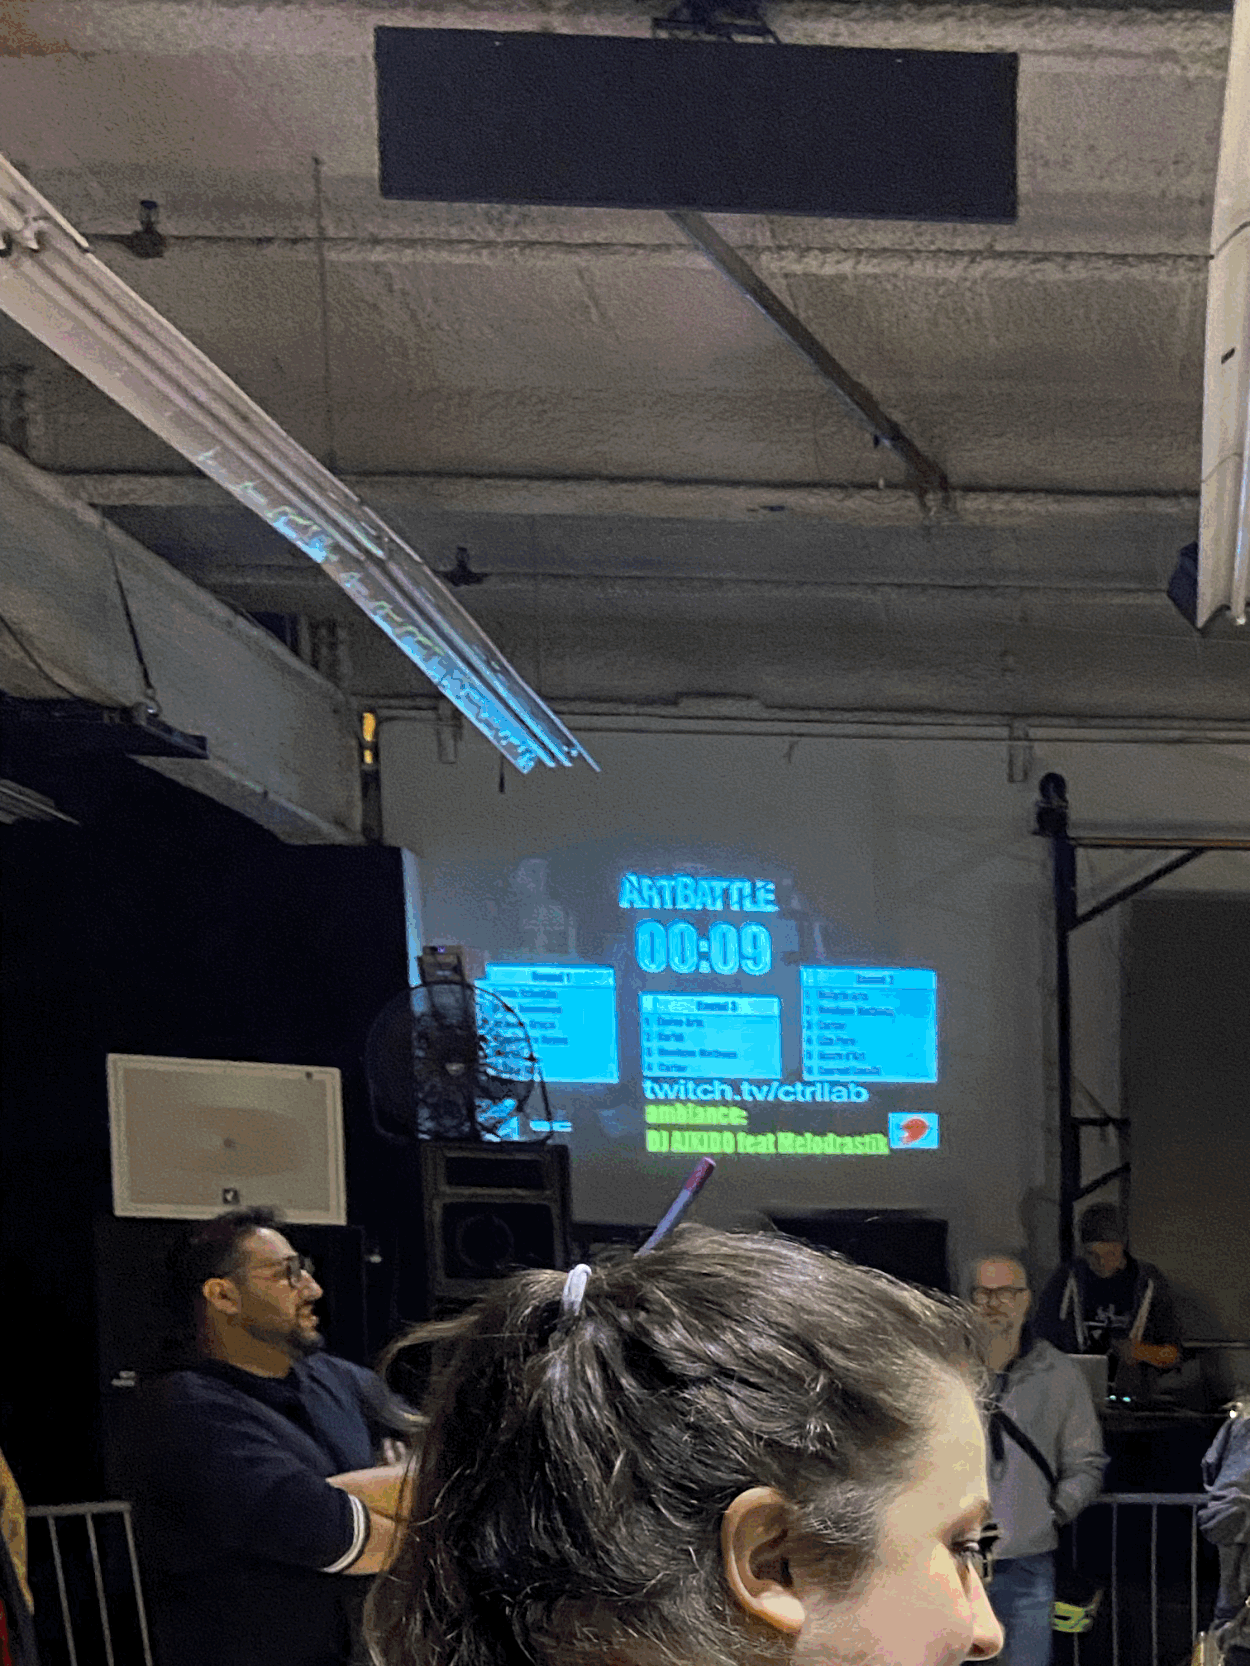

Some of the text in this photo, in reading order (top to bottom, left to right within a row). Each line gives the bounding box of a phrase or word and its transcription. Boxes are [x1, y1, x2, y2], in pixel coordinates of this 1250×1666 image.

[635, 919, 772, 975] 00:09
[642, 1079, 870, 1103] twitch.tv/ctrllab
[646, 1128, 669, 1153] DJ
[736, 1130, 776, 1154] feat
